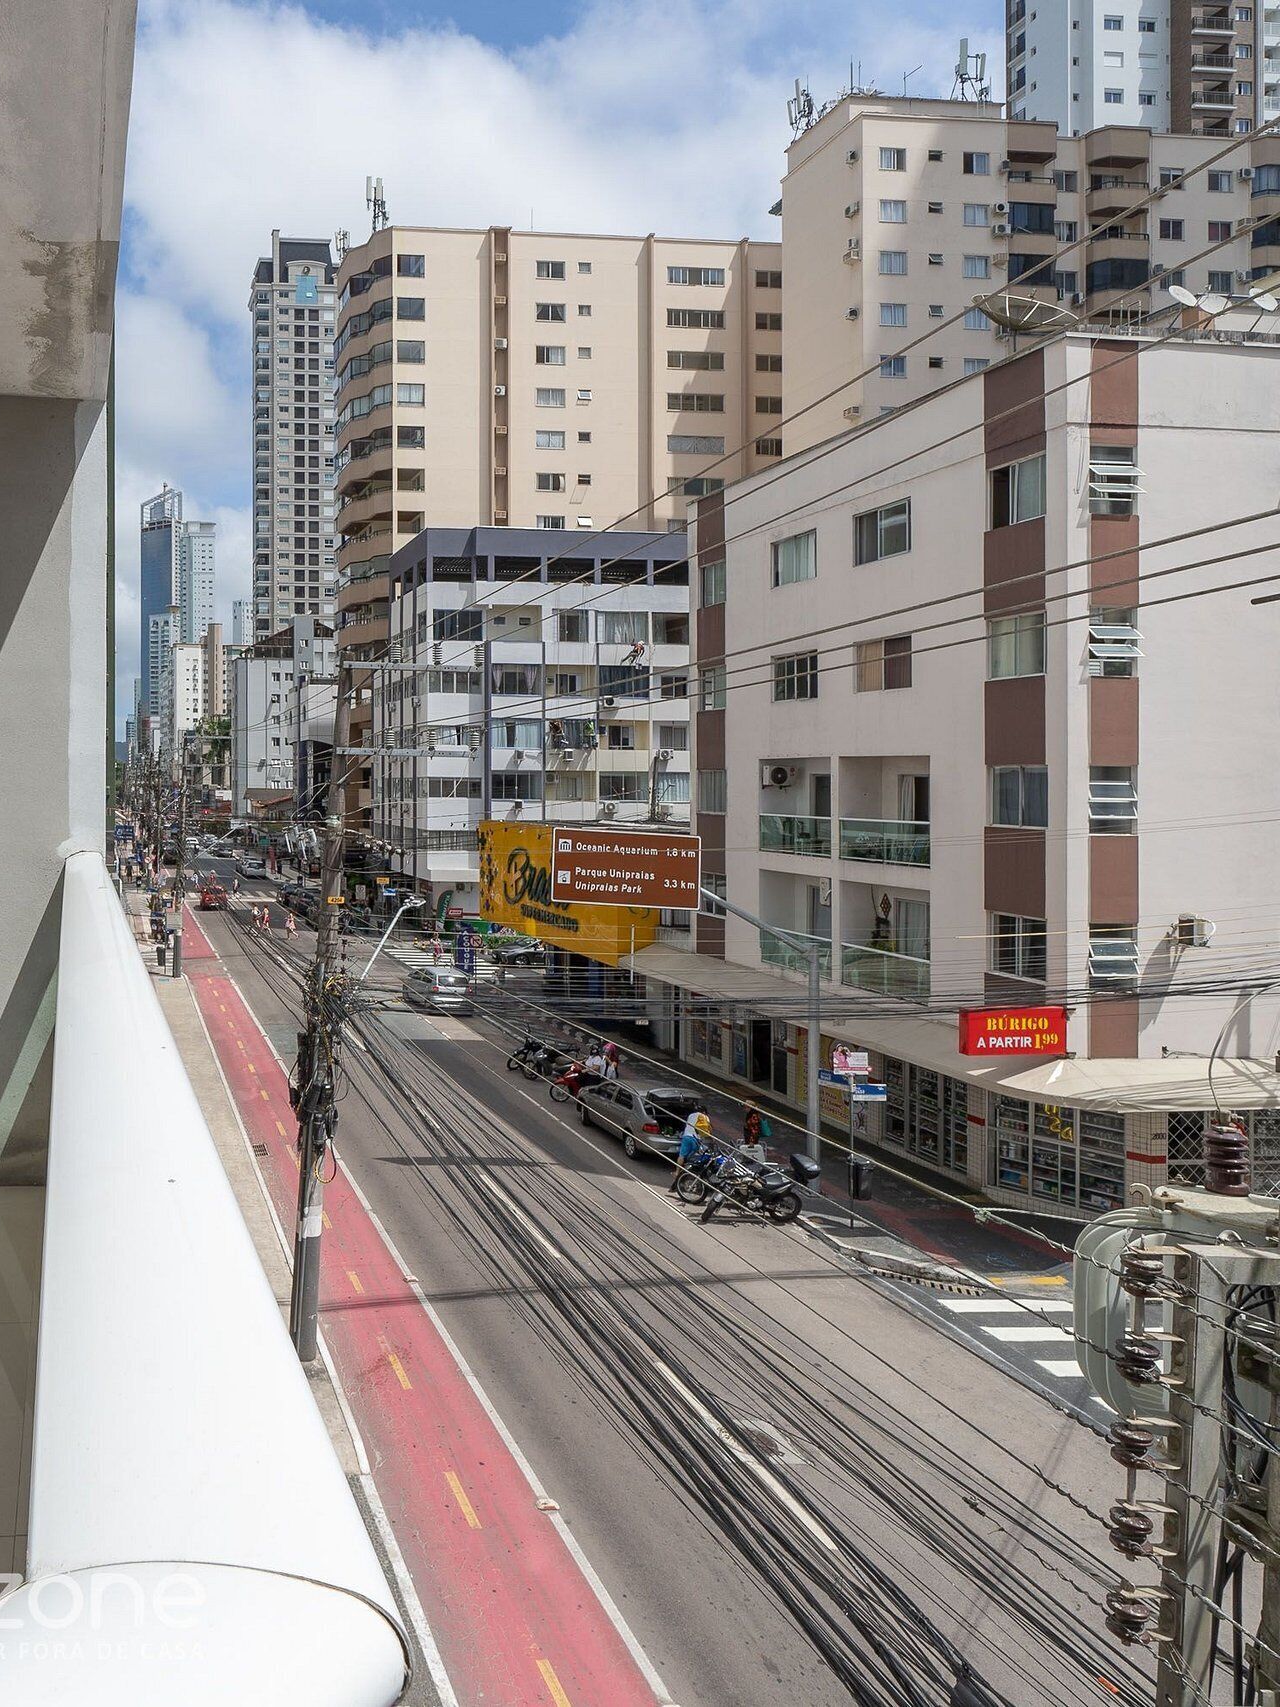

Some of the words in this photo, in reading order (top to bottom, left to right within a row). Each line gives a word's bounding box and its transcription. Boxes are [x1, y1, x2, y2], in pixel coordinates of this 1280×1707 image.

[576, 842, 611, 853] Oceanic
[613, 844, 658, 856] Aquarium
[666, 848, 678, 857] 1.8
[680, 848, 696, 858] km
[575, 867, 607, 881] Parque
[609, 869, 656, 881] Unipraias
[575, 881, 618, 893] Unipraias
[621, 884, 642, 894] Park
[663, 879, 678, 888] 3.3
[680, 879, 696, 890] km
[986, 1014, 1049, 1031] BÚRIGO
[976, 1036, 987, 1048] A
[989, 1036, 1033, 1048] PARTIR
[1034, 1032, 1060, 1050] 1,99
